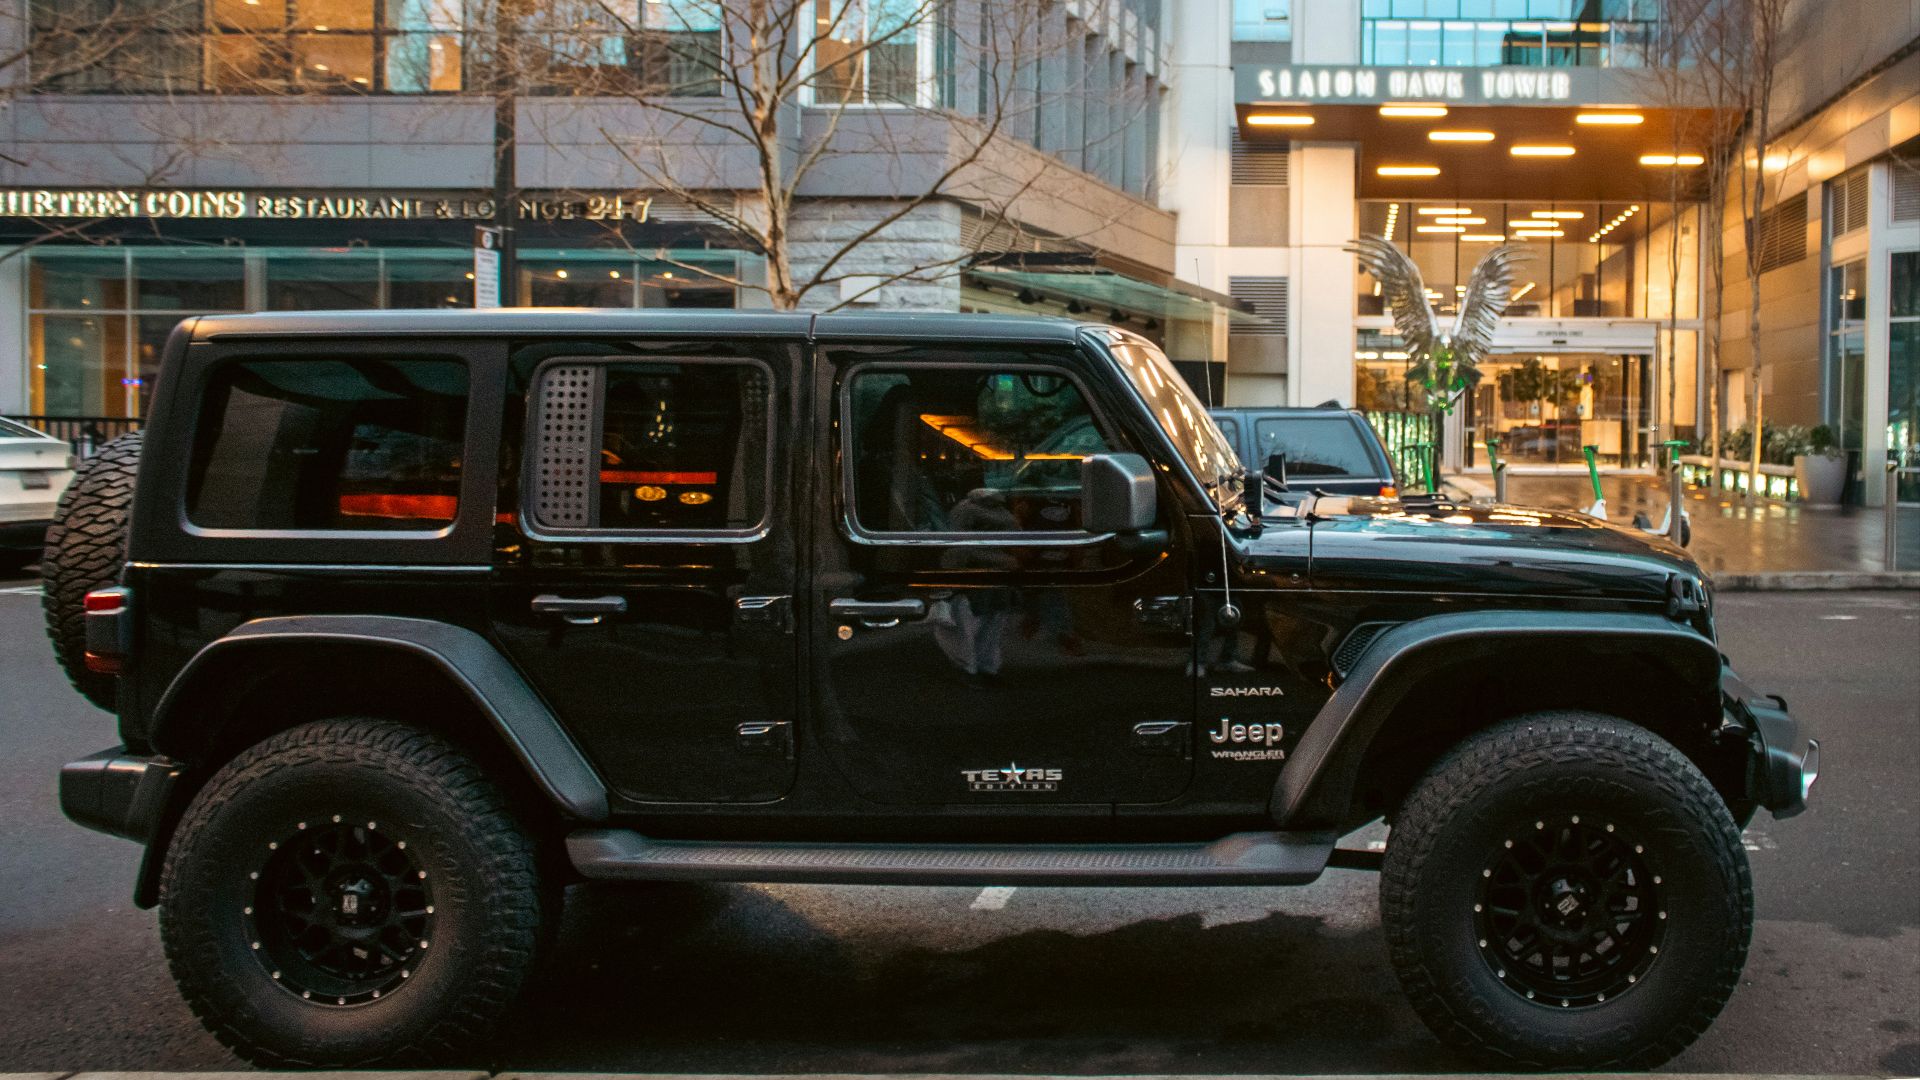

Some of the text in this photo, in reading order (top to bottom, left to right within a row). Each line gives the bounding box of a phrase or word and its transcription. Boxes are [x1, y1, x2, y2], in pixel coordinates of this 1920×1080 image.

[1389, 71, 1464, 98] HAWK
[1482, 71, 1570, 98] TOWER
[146, 190, 246, 218] COINS
[258, 195, 423, 218] RESTAURANT
[436, 199, 455, 219] &
[463, 199, 575, 219] LONGE
[1210, 687, 1284, 696] SAHARA
[1209, 718, 1284, 747] Jeep
[1211, 750, 1285, 759] WRANGLER
